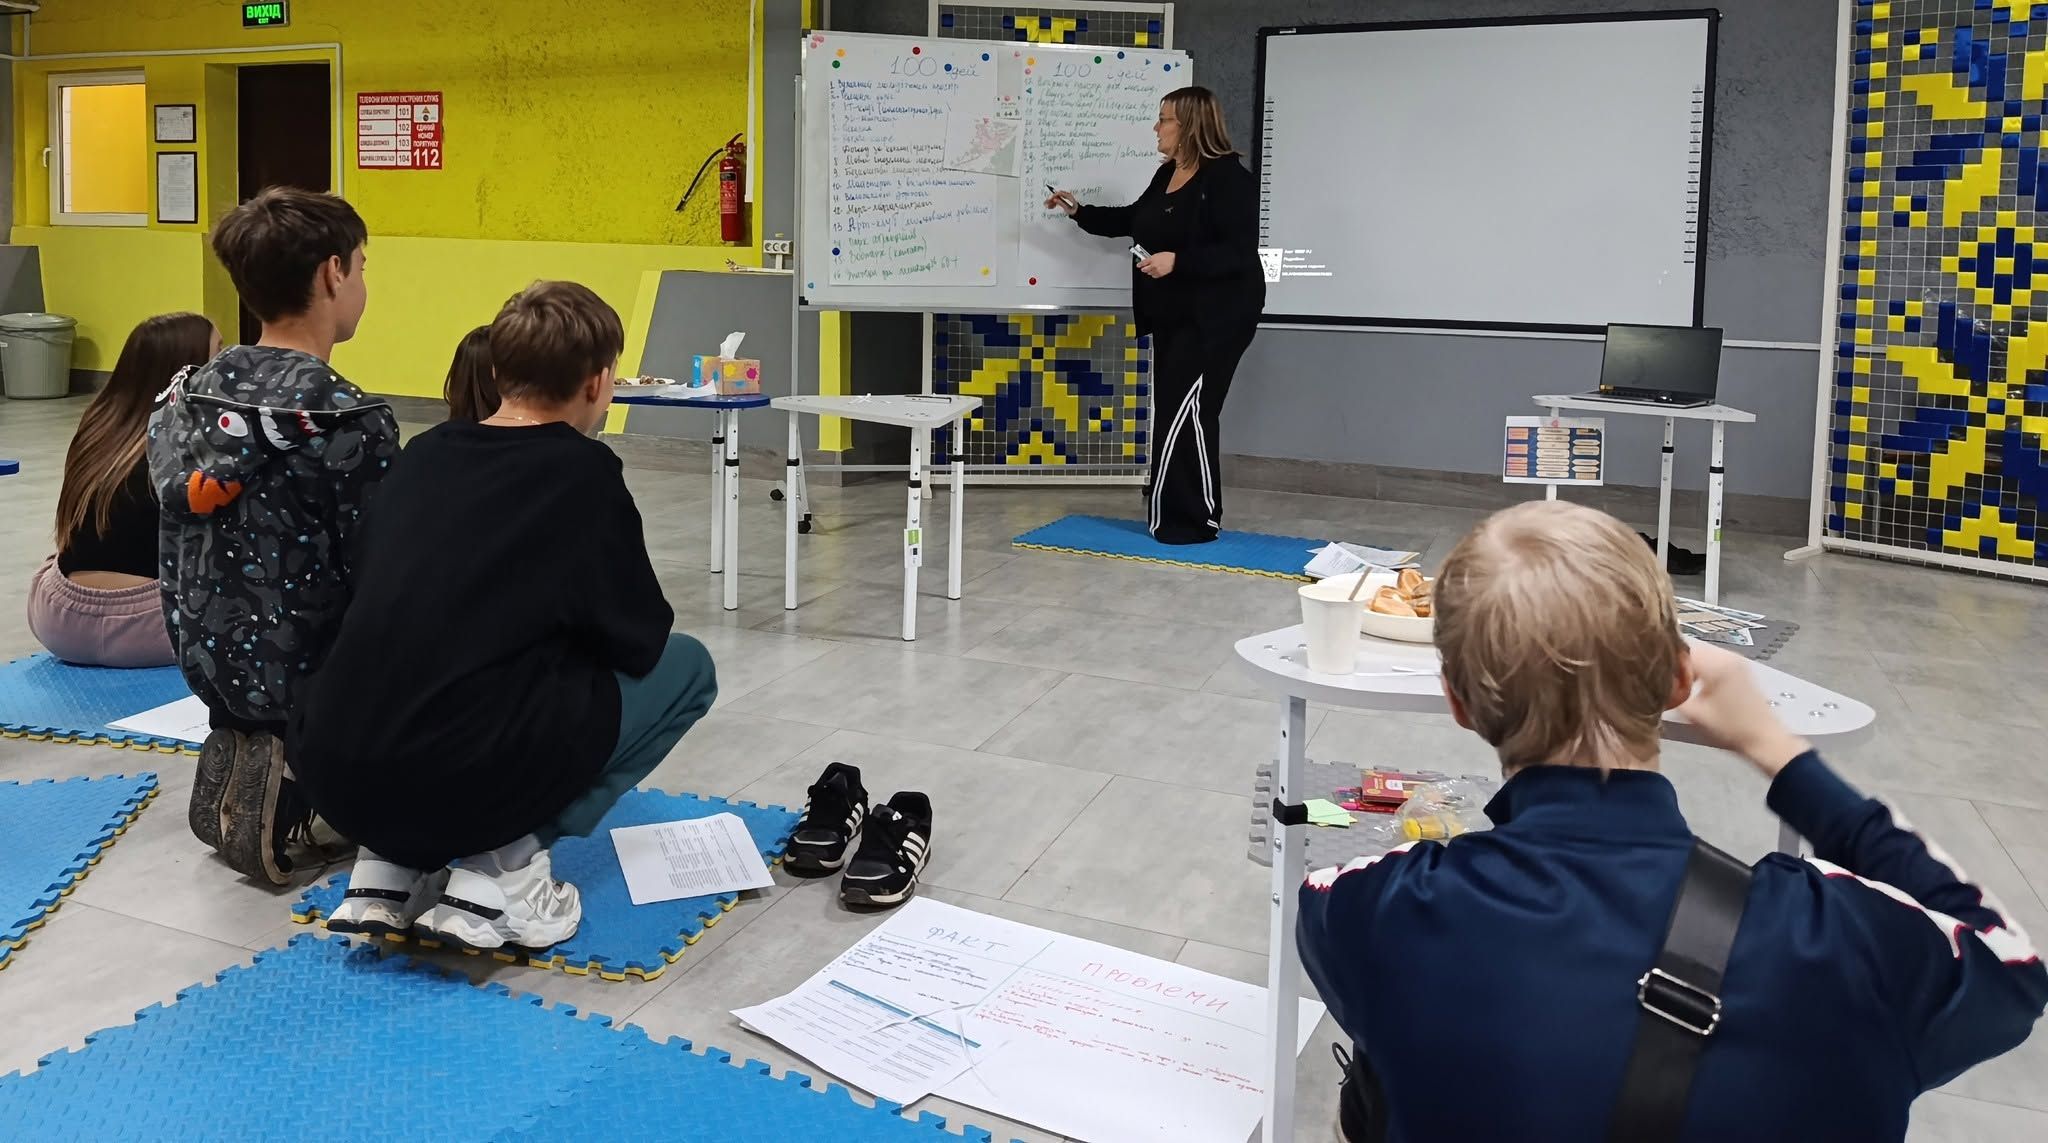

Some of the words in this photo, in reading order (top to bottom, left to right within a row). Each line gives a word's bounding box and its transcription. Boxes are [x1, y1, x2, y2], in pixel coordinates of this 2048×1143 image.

[247, 4, 281, 19] ВИХІД
[891, 56, 937, 76] 100
[950, 64, 980, 80] дей
[1052, 62, 1091, 78] 100
[400, 95, 423, 103] ЕКСТРЕНИХ
[399, 108, 409, 116] 101
[399, 139, 409, 147] 103
[413, 148, 439, 166] 112
[926, 927, 1009, 951] ФАКТ
[1081, 963, 1230, 1013] ПРОБЛЕМИ
